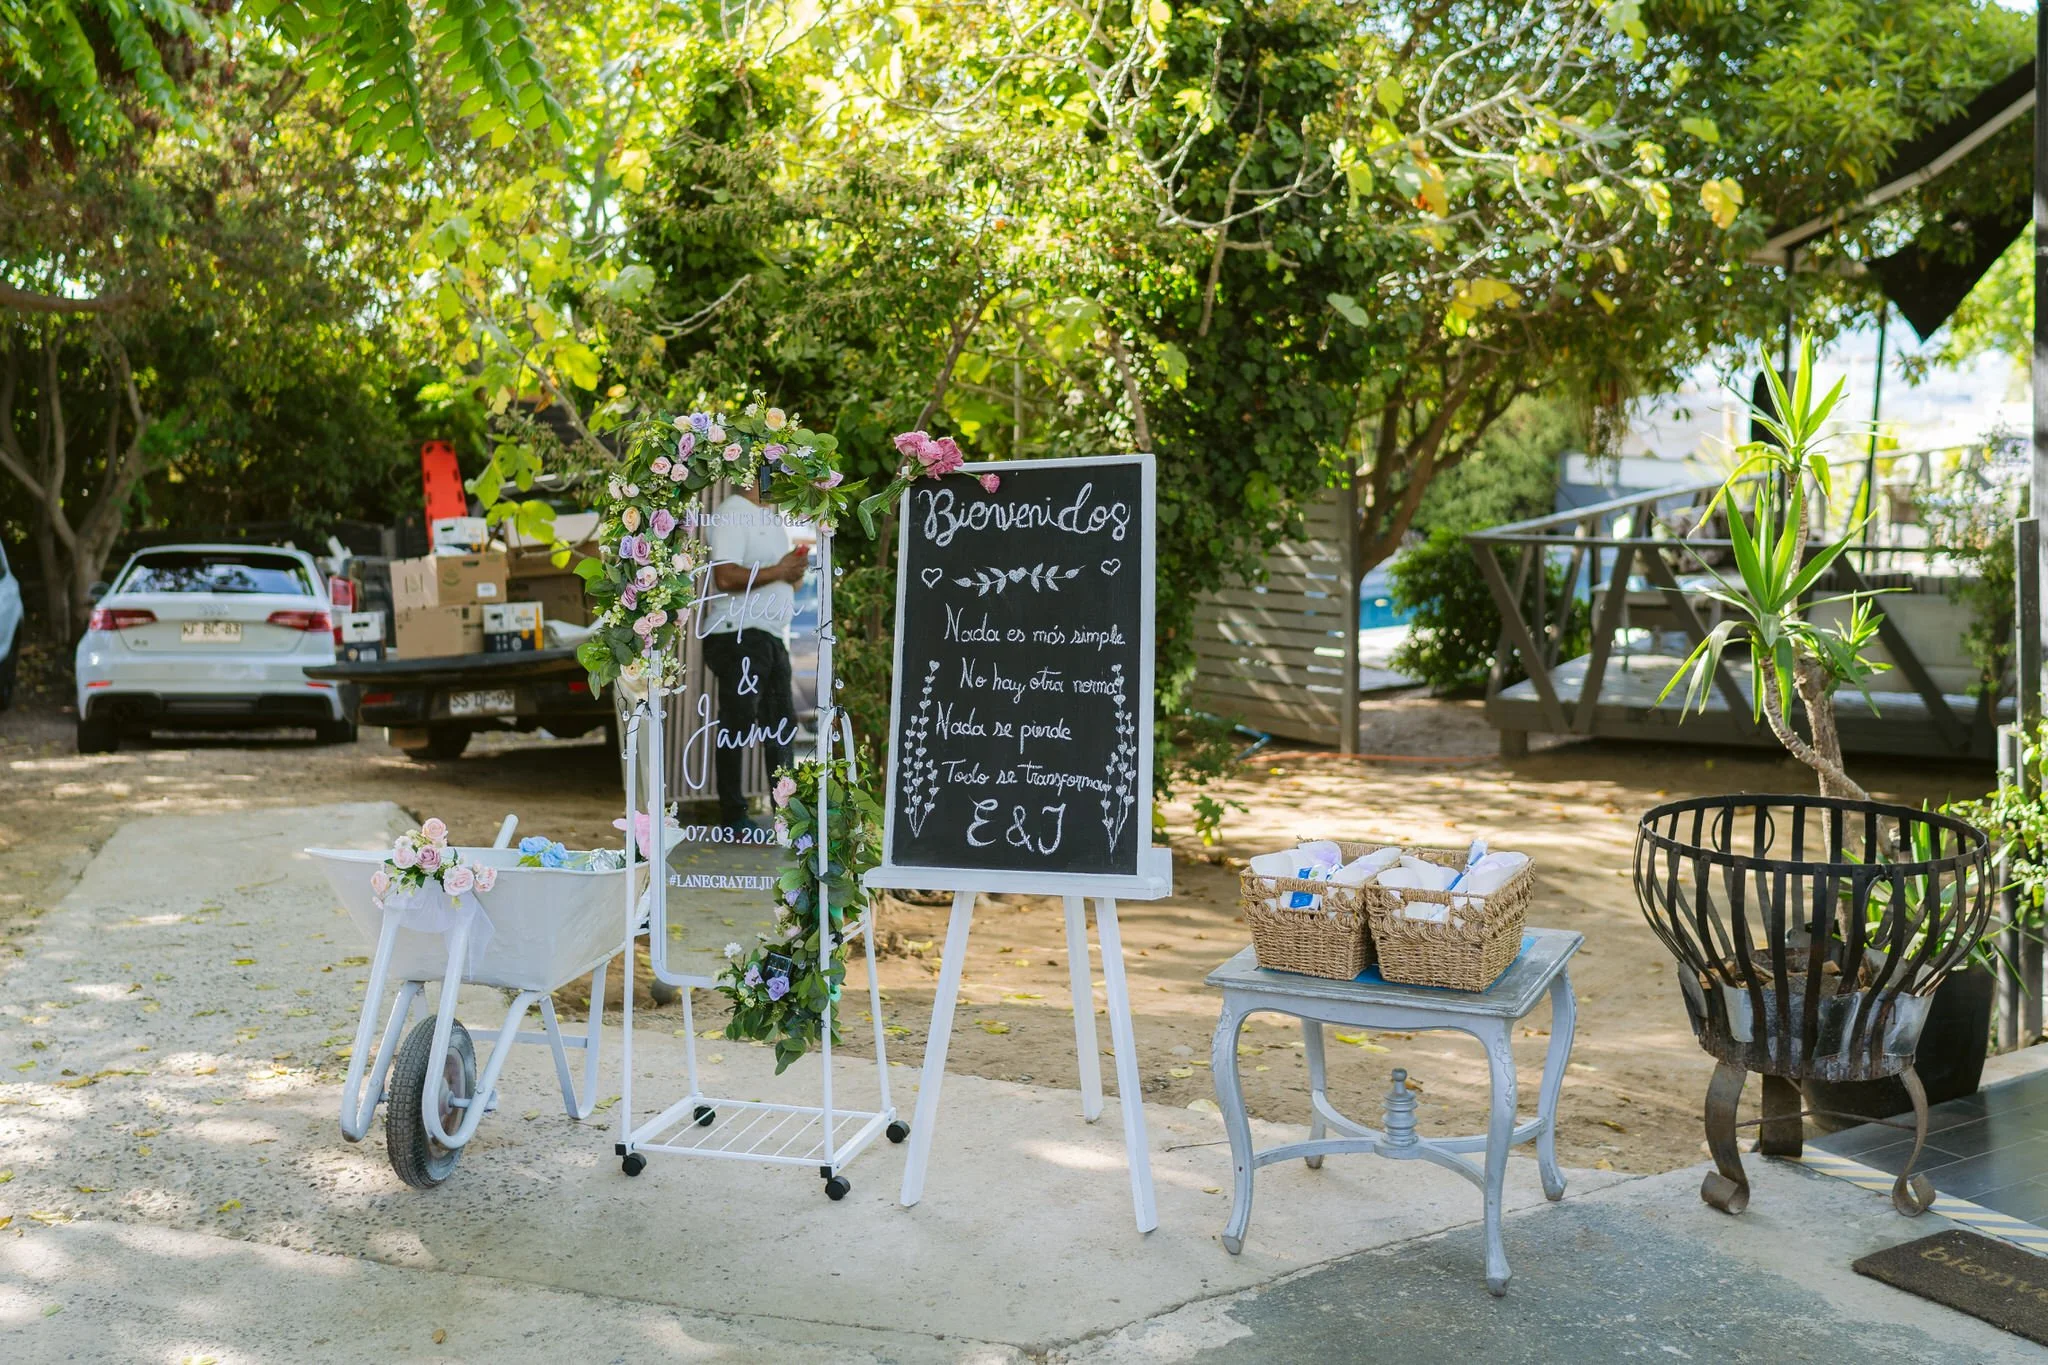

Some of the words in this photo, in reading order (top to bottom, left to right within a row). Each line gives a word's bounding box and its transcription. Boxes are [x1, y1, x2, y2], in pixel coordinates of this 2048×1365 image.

[684, 508, 754, 527] Nuestra
[917, 482, 1132, 547] Bienvenidos
[687, 559, 805, 645] Eileen
[944, 602, 1001, 642] Nada
[1006, 628, 1026, 642] es
[1033, 625, 1065, 644] más
[1070, 623, 1126, 652] simple
[737, 656, 759, 696] &
[959, 656, 987, 689] No
[992, 662, 1026, 704] hay
[1029, 666, 1064, 692] otra
[1073, 679, 1119, 695] norma
[683, 693, 799, 790] Jaime
[935, 700, 987, 740] Nada
[992, 720, 1014, 738] se
[1020, 717, 1073, 755] pierde
[941, 758, 990, 785] Todo
[995, 769, 1018, 785] se
[1017, 760, 1104, 797] transforma
[686, 825, 777, 846] 07.03.202
